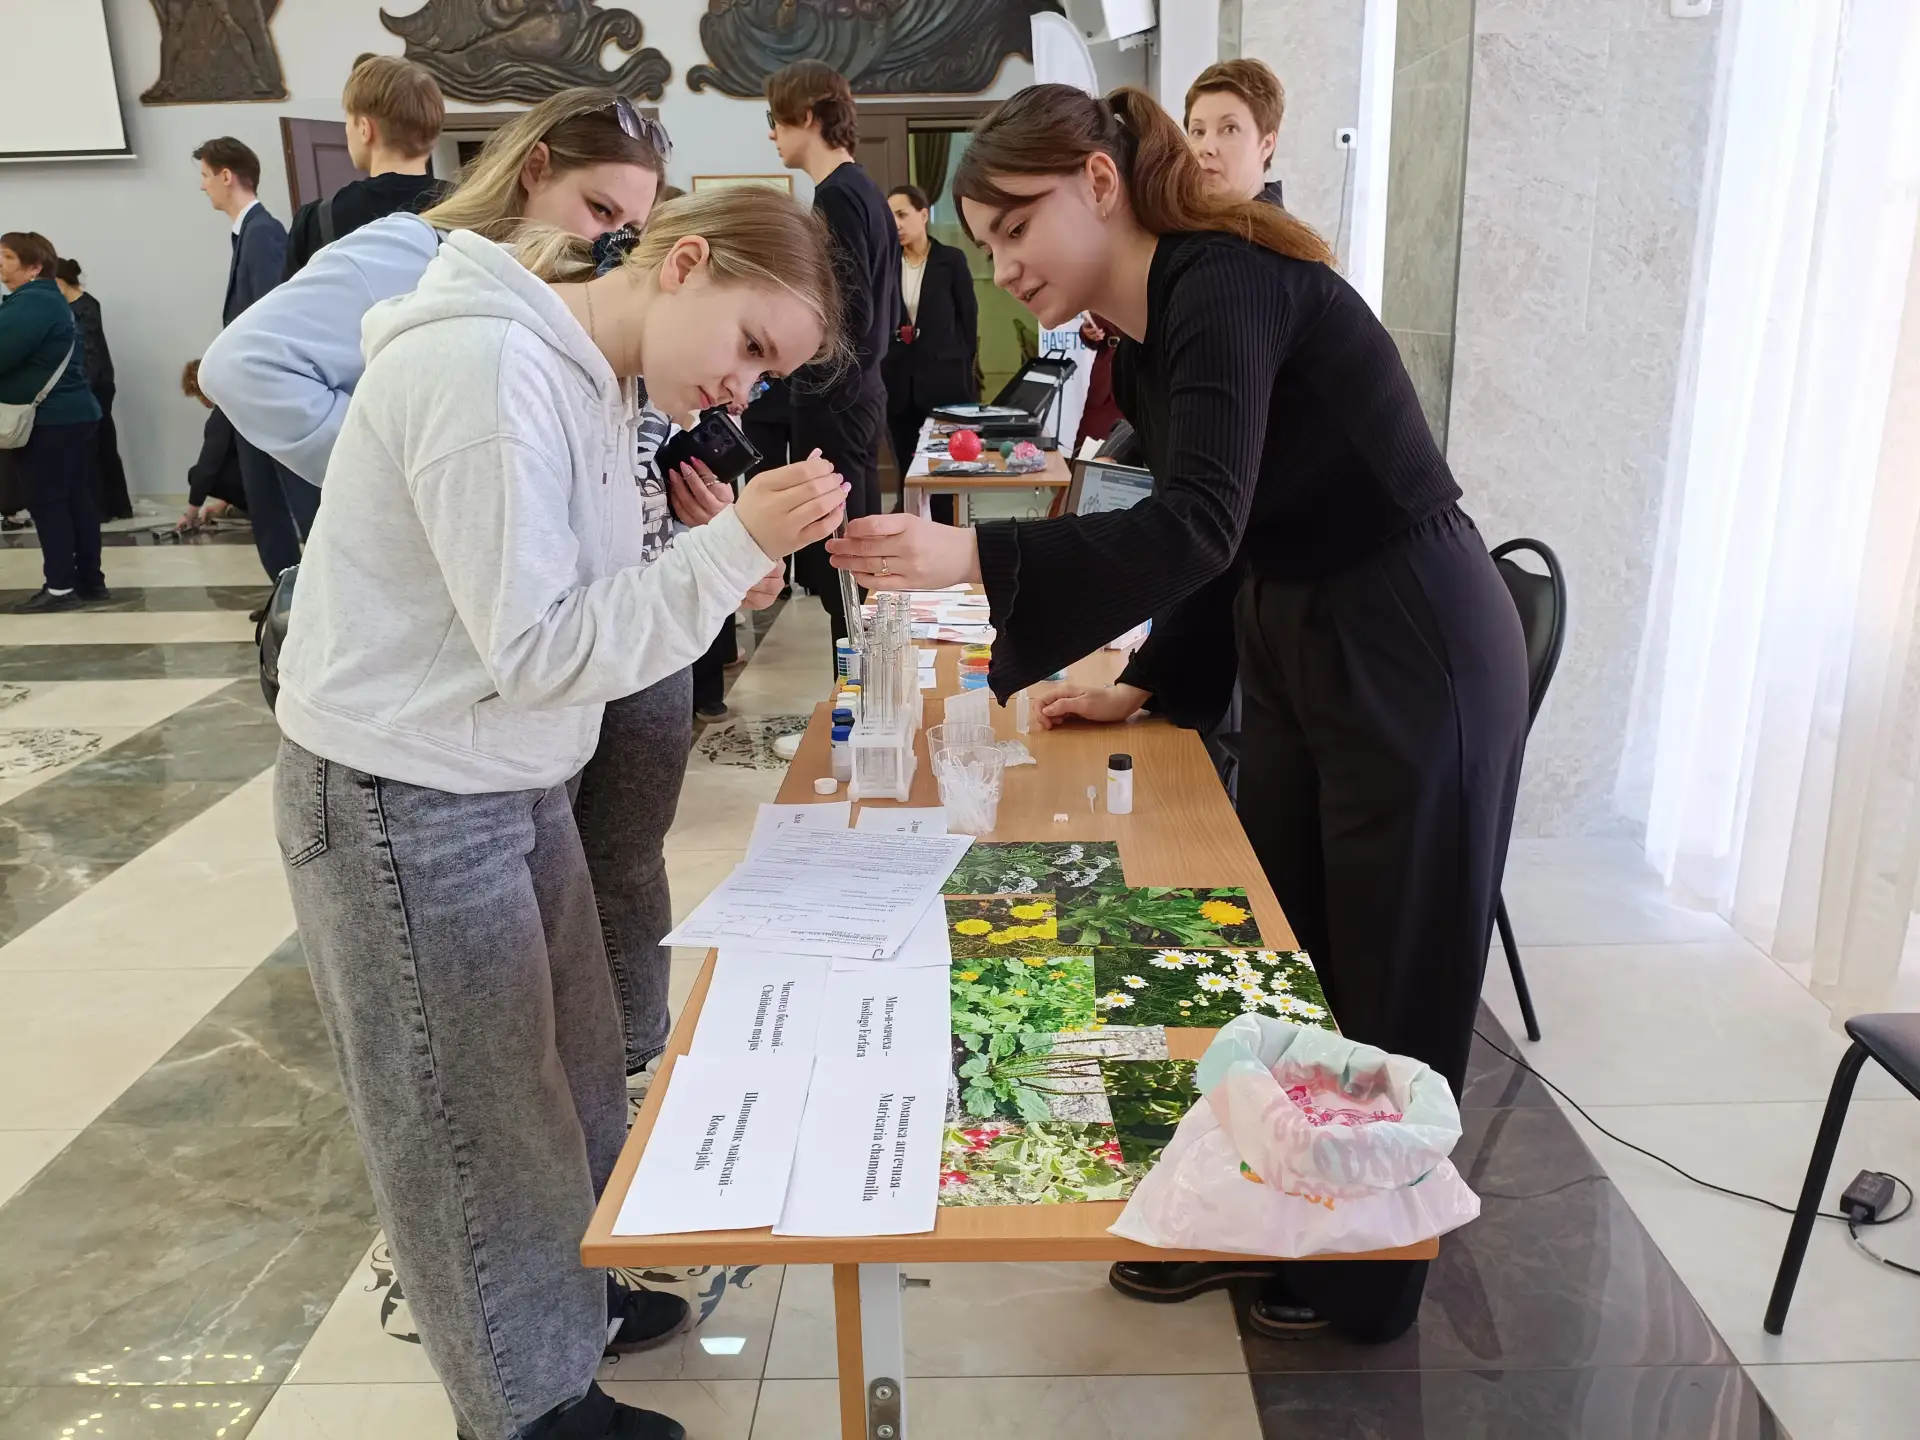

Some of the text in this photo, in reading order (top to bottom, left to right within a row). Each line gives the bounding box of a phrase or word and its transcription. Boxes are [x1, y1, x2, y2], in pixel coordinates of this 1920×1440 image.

[747, 984, 775, 1052] Chelidonium majus
[778, 980, 796, 1013] Чистотел
[771, 1013, 789, 1047] большой
[856, 996, 875, 1058] Tussilago Farfara
[882, 996, 898, 1050] Мать-и-мачеха
[731, 1092, 759, 1142] Шиповник
[896, 1095, 916, 1138] Ромашка
[693, 1114, 726, 1171] Rosa majalis
[718, 1143, 741, 1186] майский
[862, 1092, 894, 1202] Matricaria chamomilla
[889, 1140, 906, 1189] аптечная
